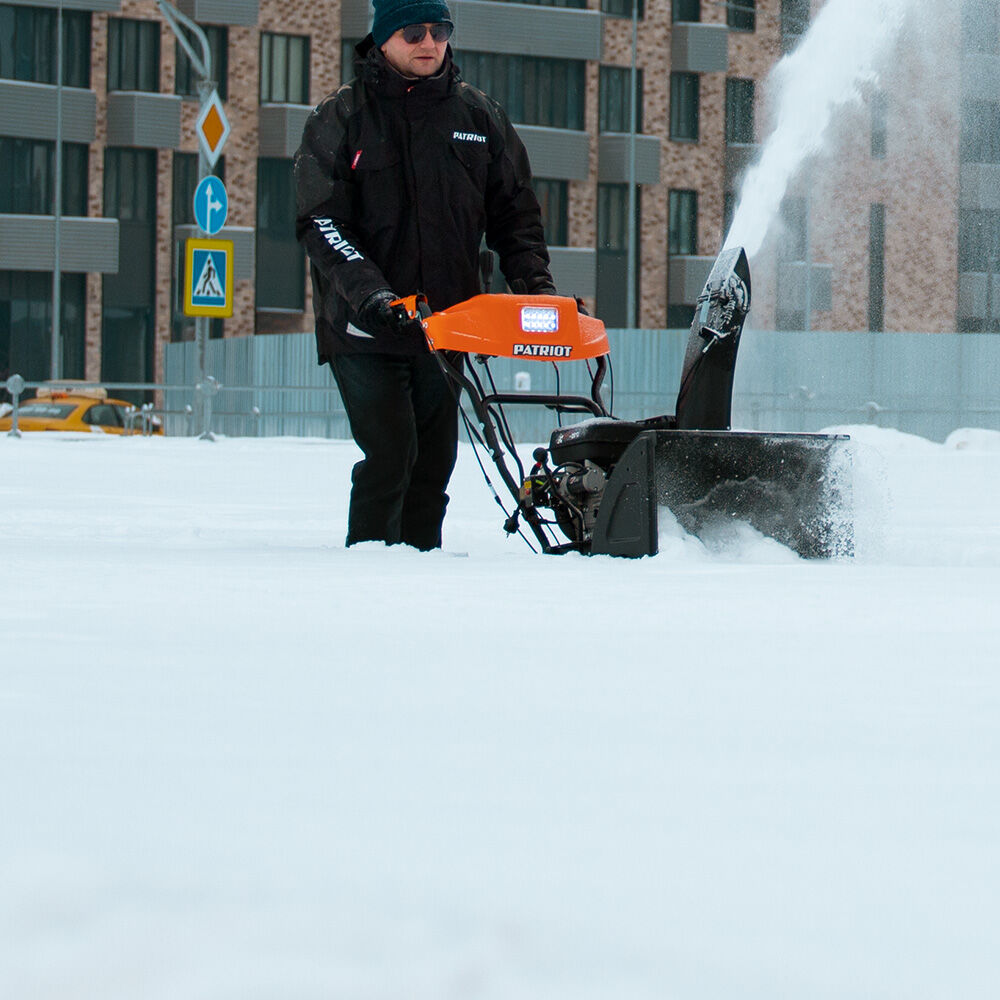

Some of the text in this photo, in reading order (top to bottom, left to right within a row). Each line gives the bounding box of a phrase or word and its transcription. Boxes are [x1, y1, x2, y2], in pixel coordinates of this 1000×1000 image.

[453, 131, 487, 143] PATRIOT
[313, 218, 364, 261] ATRIOT
[513, 344, 572, 357] PATRIOT
